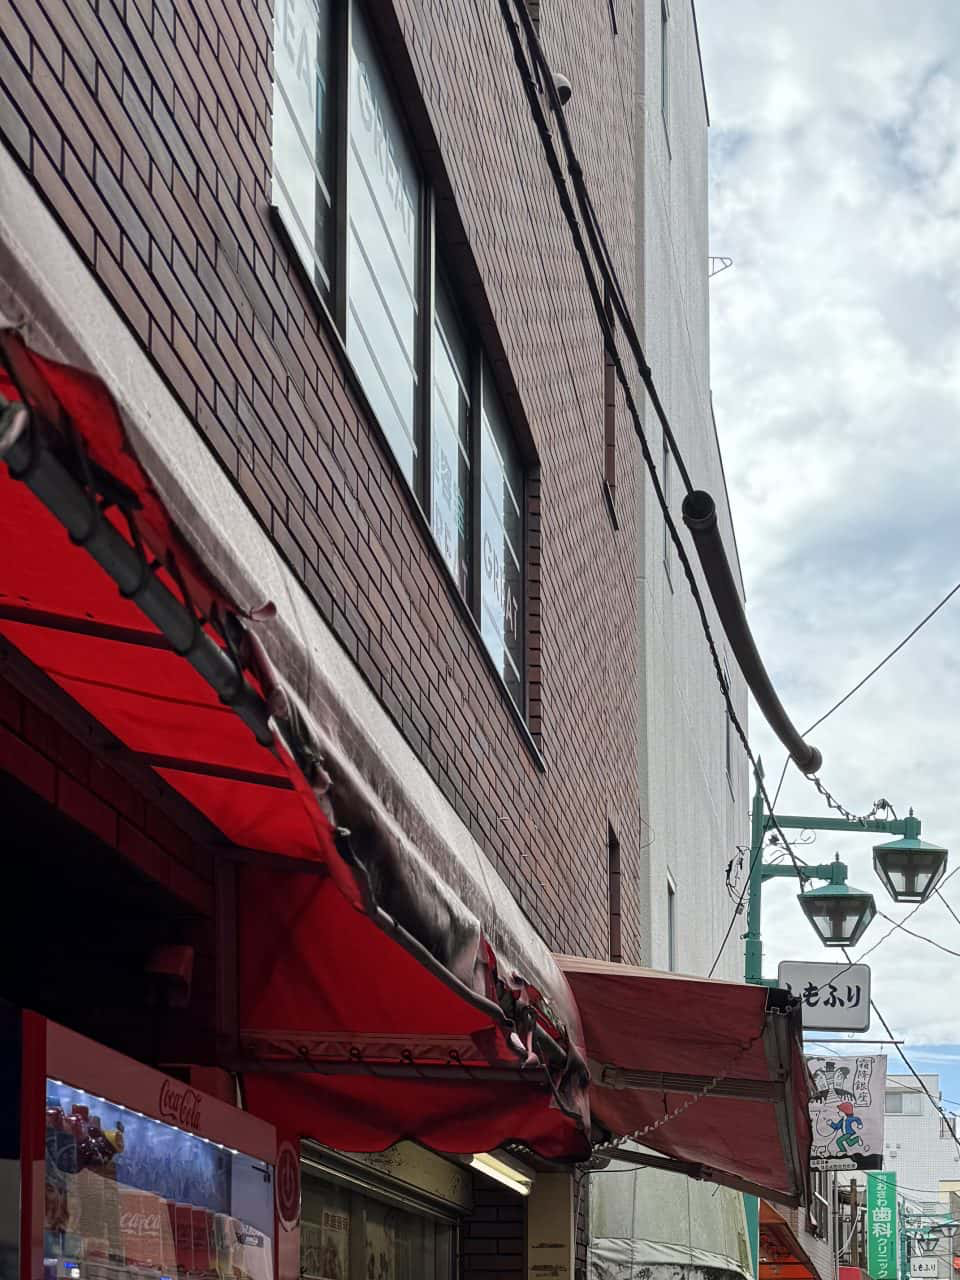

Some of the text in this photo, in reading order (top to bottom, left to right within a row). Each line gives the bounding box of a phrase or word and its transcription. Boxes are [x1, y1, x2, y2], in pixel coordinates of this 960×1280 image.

[483, 532, 518, 640] GREAT
[912, 1263, 936, 1272] しもふり
